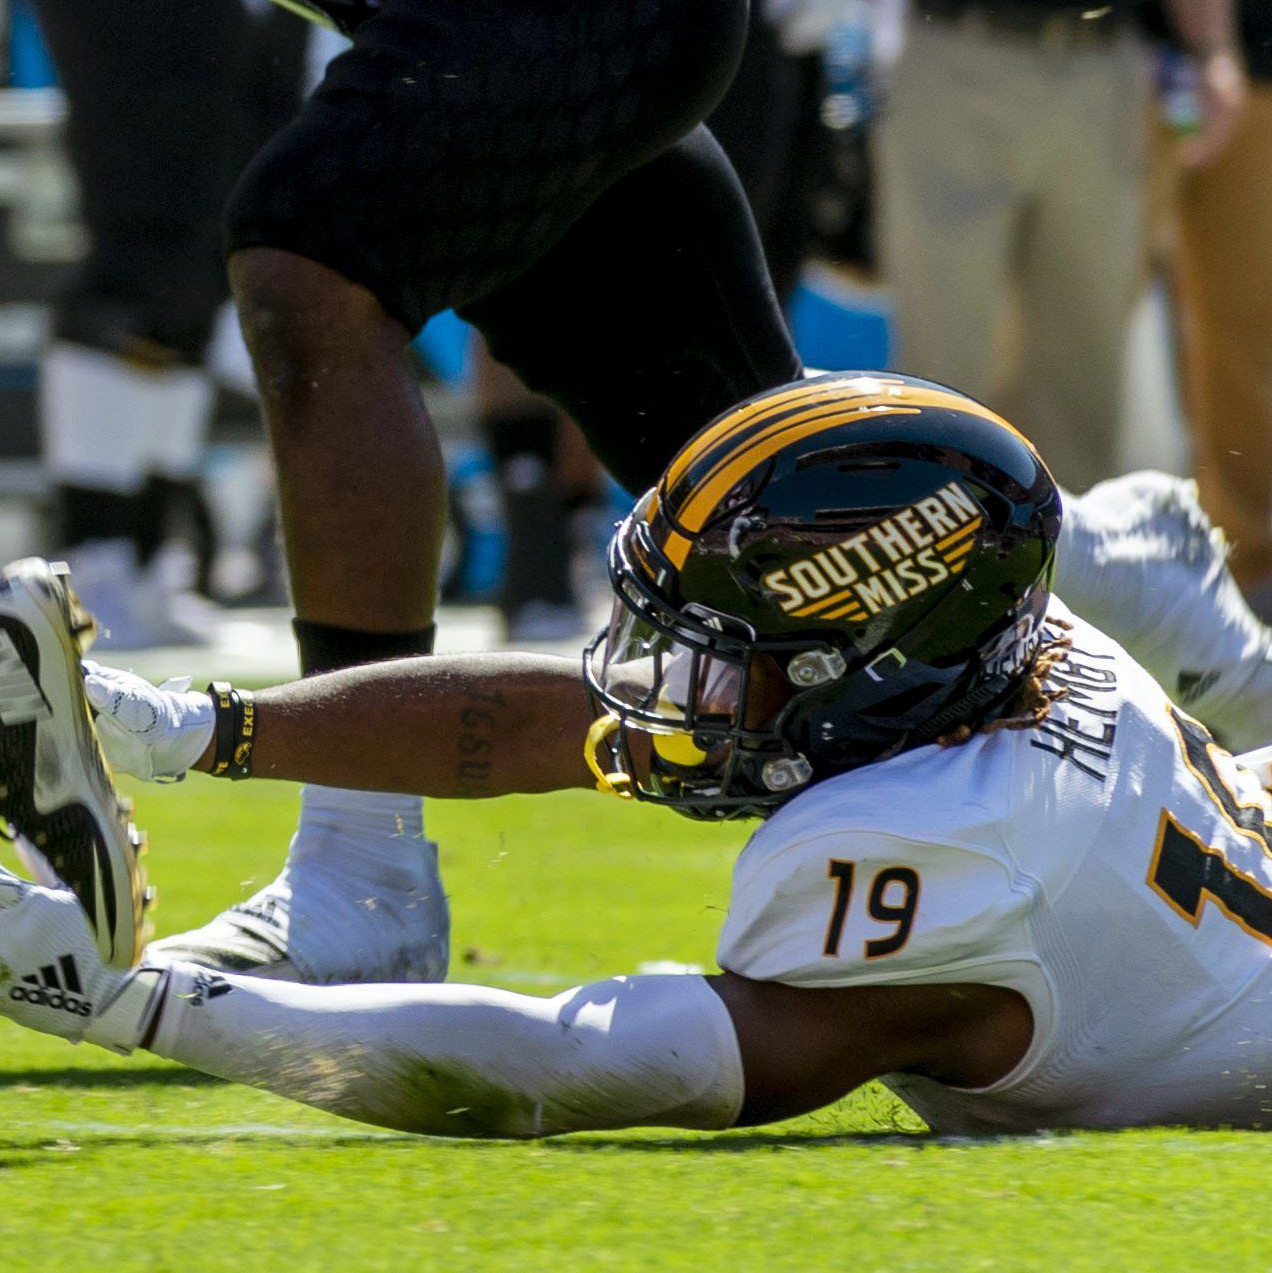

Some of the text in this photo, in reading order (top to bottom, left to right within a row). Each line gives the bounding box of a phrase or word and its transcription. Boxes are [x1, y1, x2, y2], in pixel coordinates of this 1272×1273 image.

[764, 481, 980, 613] SOUTHERN
[852, 548, 950, 616] MISS
[822, 857, 922, 961] 19
[9, 984, 93, 1018] adidas
